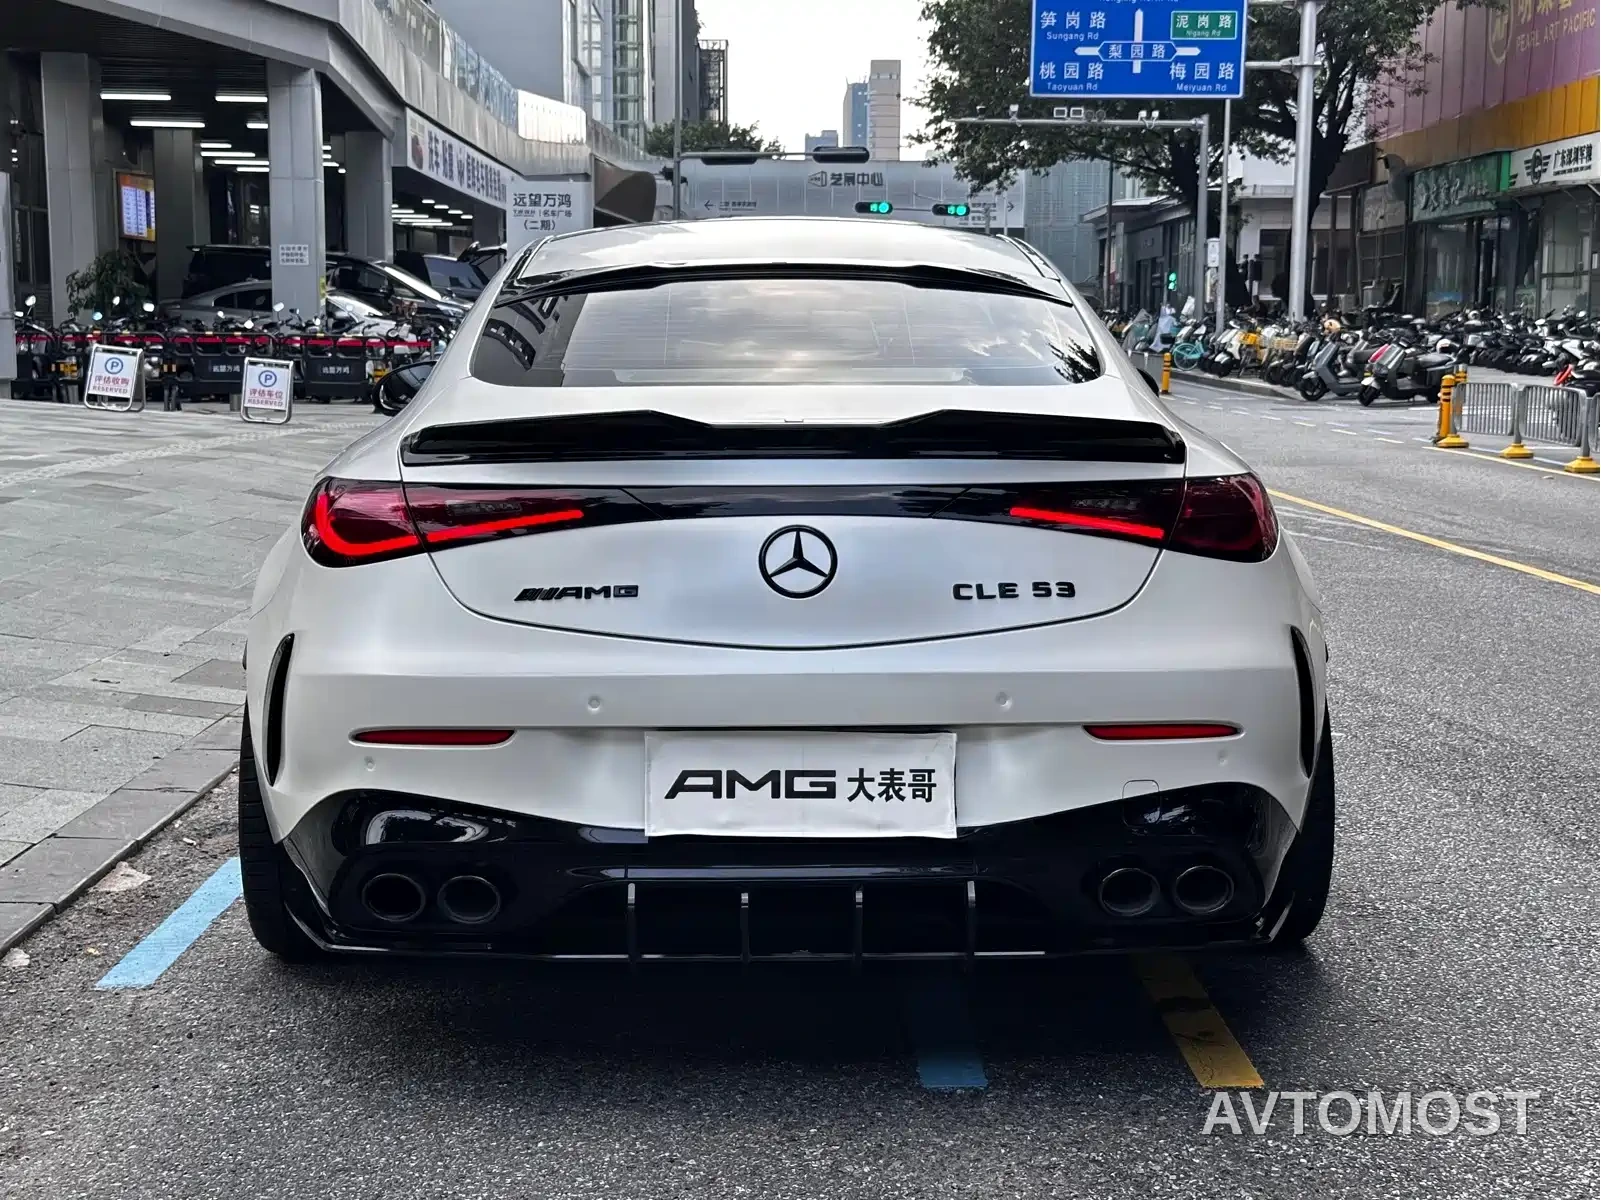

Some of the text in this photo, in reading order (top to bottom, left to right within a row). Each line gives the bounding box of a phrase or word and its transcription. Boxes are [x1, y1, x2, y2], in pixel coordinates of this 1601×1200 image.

[1040, 11, 1106, 29] 笋岗路
[1176, 14, 1232, 29] 泥岗路
[1046, 32, 1099, 41] Sungang Rd
[1516, 29, 1541, 52] PEARL
[1543, 20, 1560, 44] ART
[1563, 8, 1596, 36] PACIFIC
[1108, 44, 1165, 59] 梨园路
[1039, 62, 1104, 80] 桃园路
[1170, 62, 1235, 80] 梅园路
[1047, 83, 1098, 92] Taoyuan Rd
[1176, 83, 1227, 92] Meiyuan Rd
[513, 193, 572, 208] 远望万鸿
[92, 386, 128, 394] RESERVED
[248, 399, 283, 407] RESERVED
[558, 584, 639, 600] AMG
[952, 581, 1076, 600] CLE 53
[663, 767, 937, 803] AMG 大表哥
